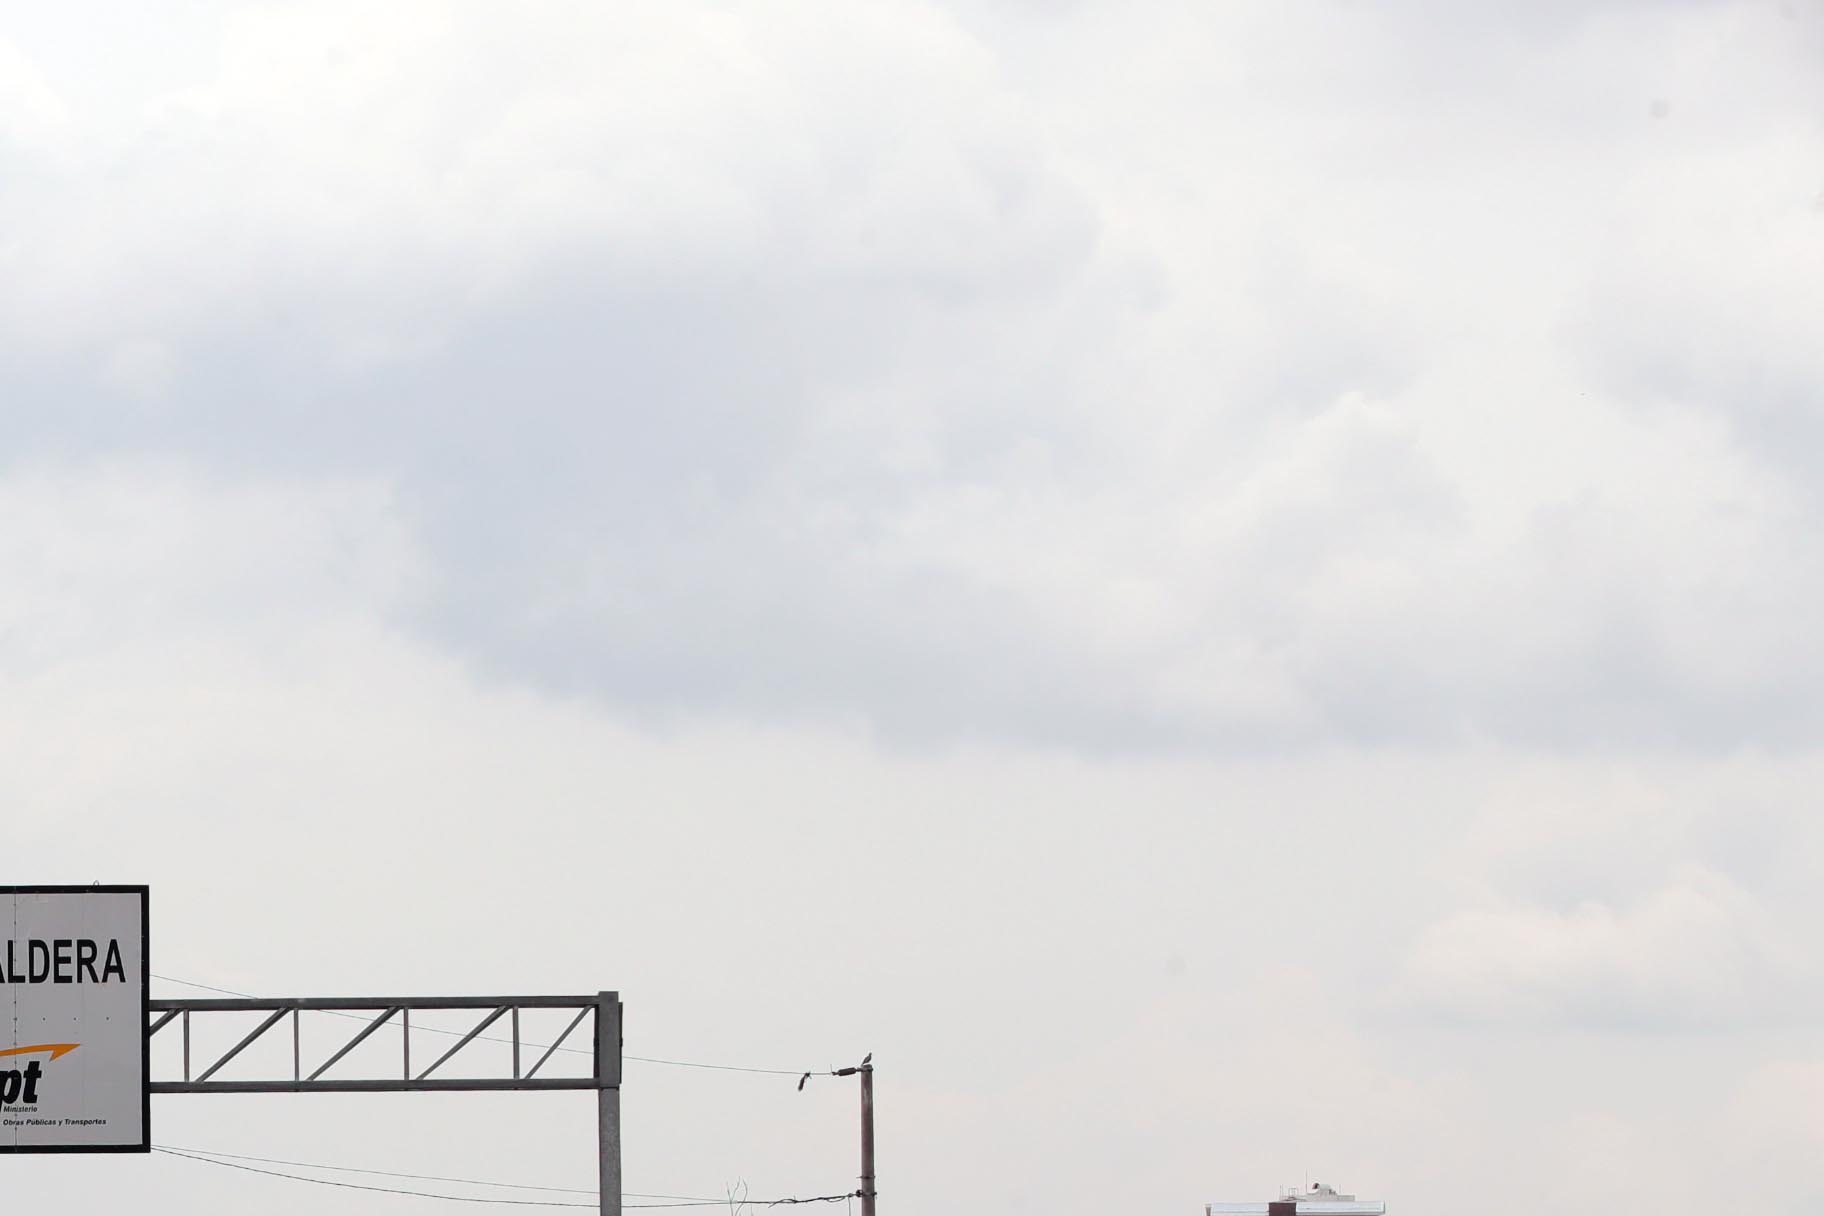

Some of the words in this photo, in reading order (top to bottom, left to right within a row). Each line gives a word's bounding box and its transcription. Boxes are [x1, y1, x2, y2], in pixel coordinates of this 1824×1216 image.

[3, 1105, 38, 1113] Ministerio
[3, 1118, 24, 1126] Obras
[26, 1117, 56, 1126] Públicas
[58, 1119, 63, 1127] y
[65, 1117, 107, 1126] Transportes
